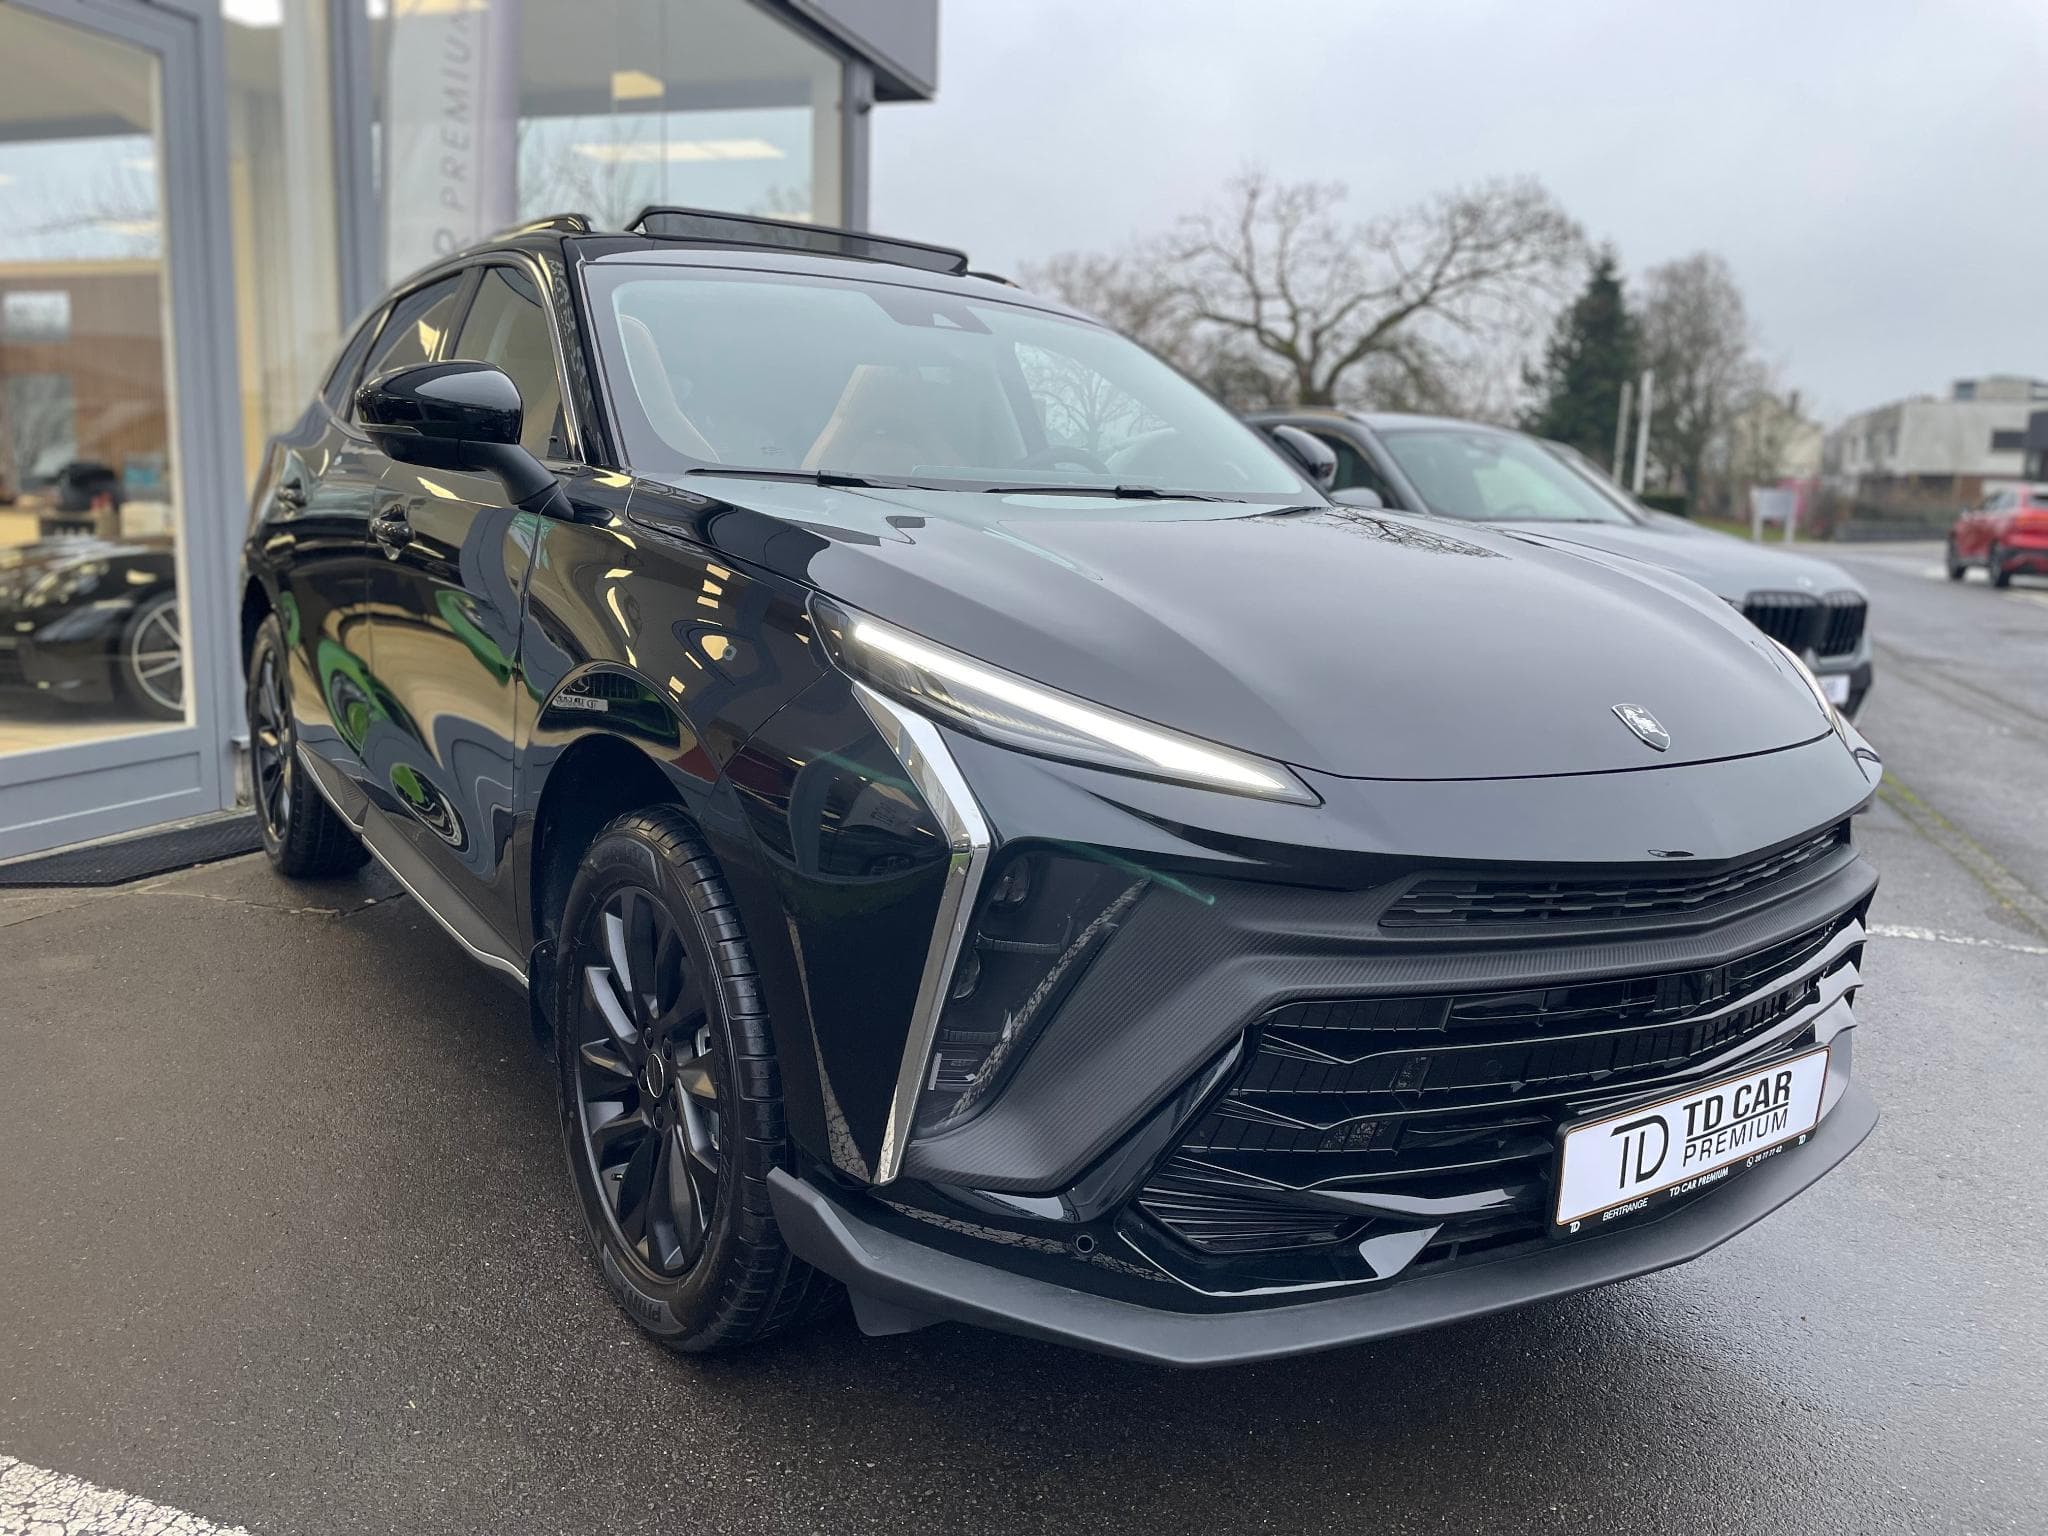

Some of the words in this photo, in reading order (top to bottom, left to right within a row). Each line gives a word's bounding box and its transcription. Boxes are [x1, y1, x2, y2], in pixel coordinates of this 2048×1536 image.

[1682, 1094, 1724, 1138] TD
[1732, 1070, 1793, 1120] CAR
[1610, 1114, 1669, 1189] TD
[1682, 1107, 1788, 1168] PREMIUM
[1602, 1197, 1649, 1222] BERTRANGE
[1670, 1186, 1680, 1198] TD
[1681, 1179, 1697, 1193] CAR
[1697, 1166, 1729, 1187] PREMIUM
